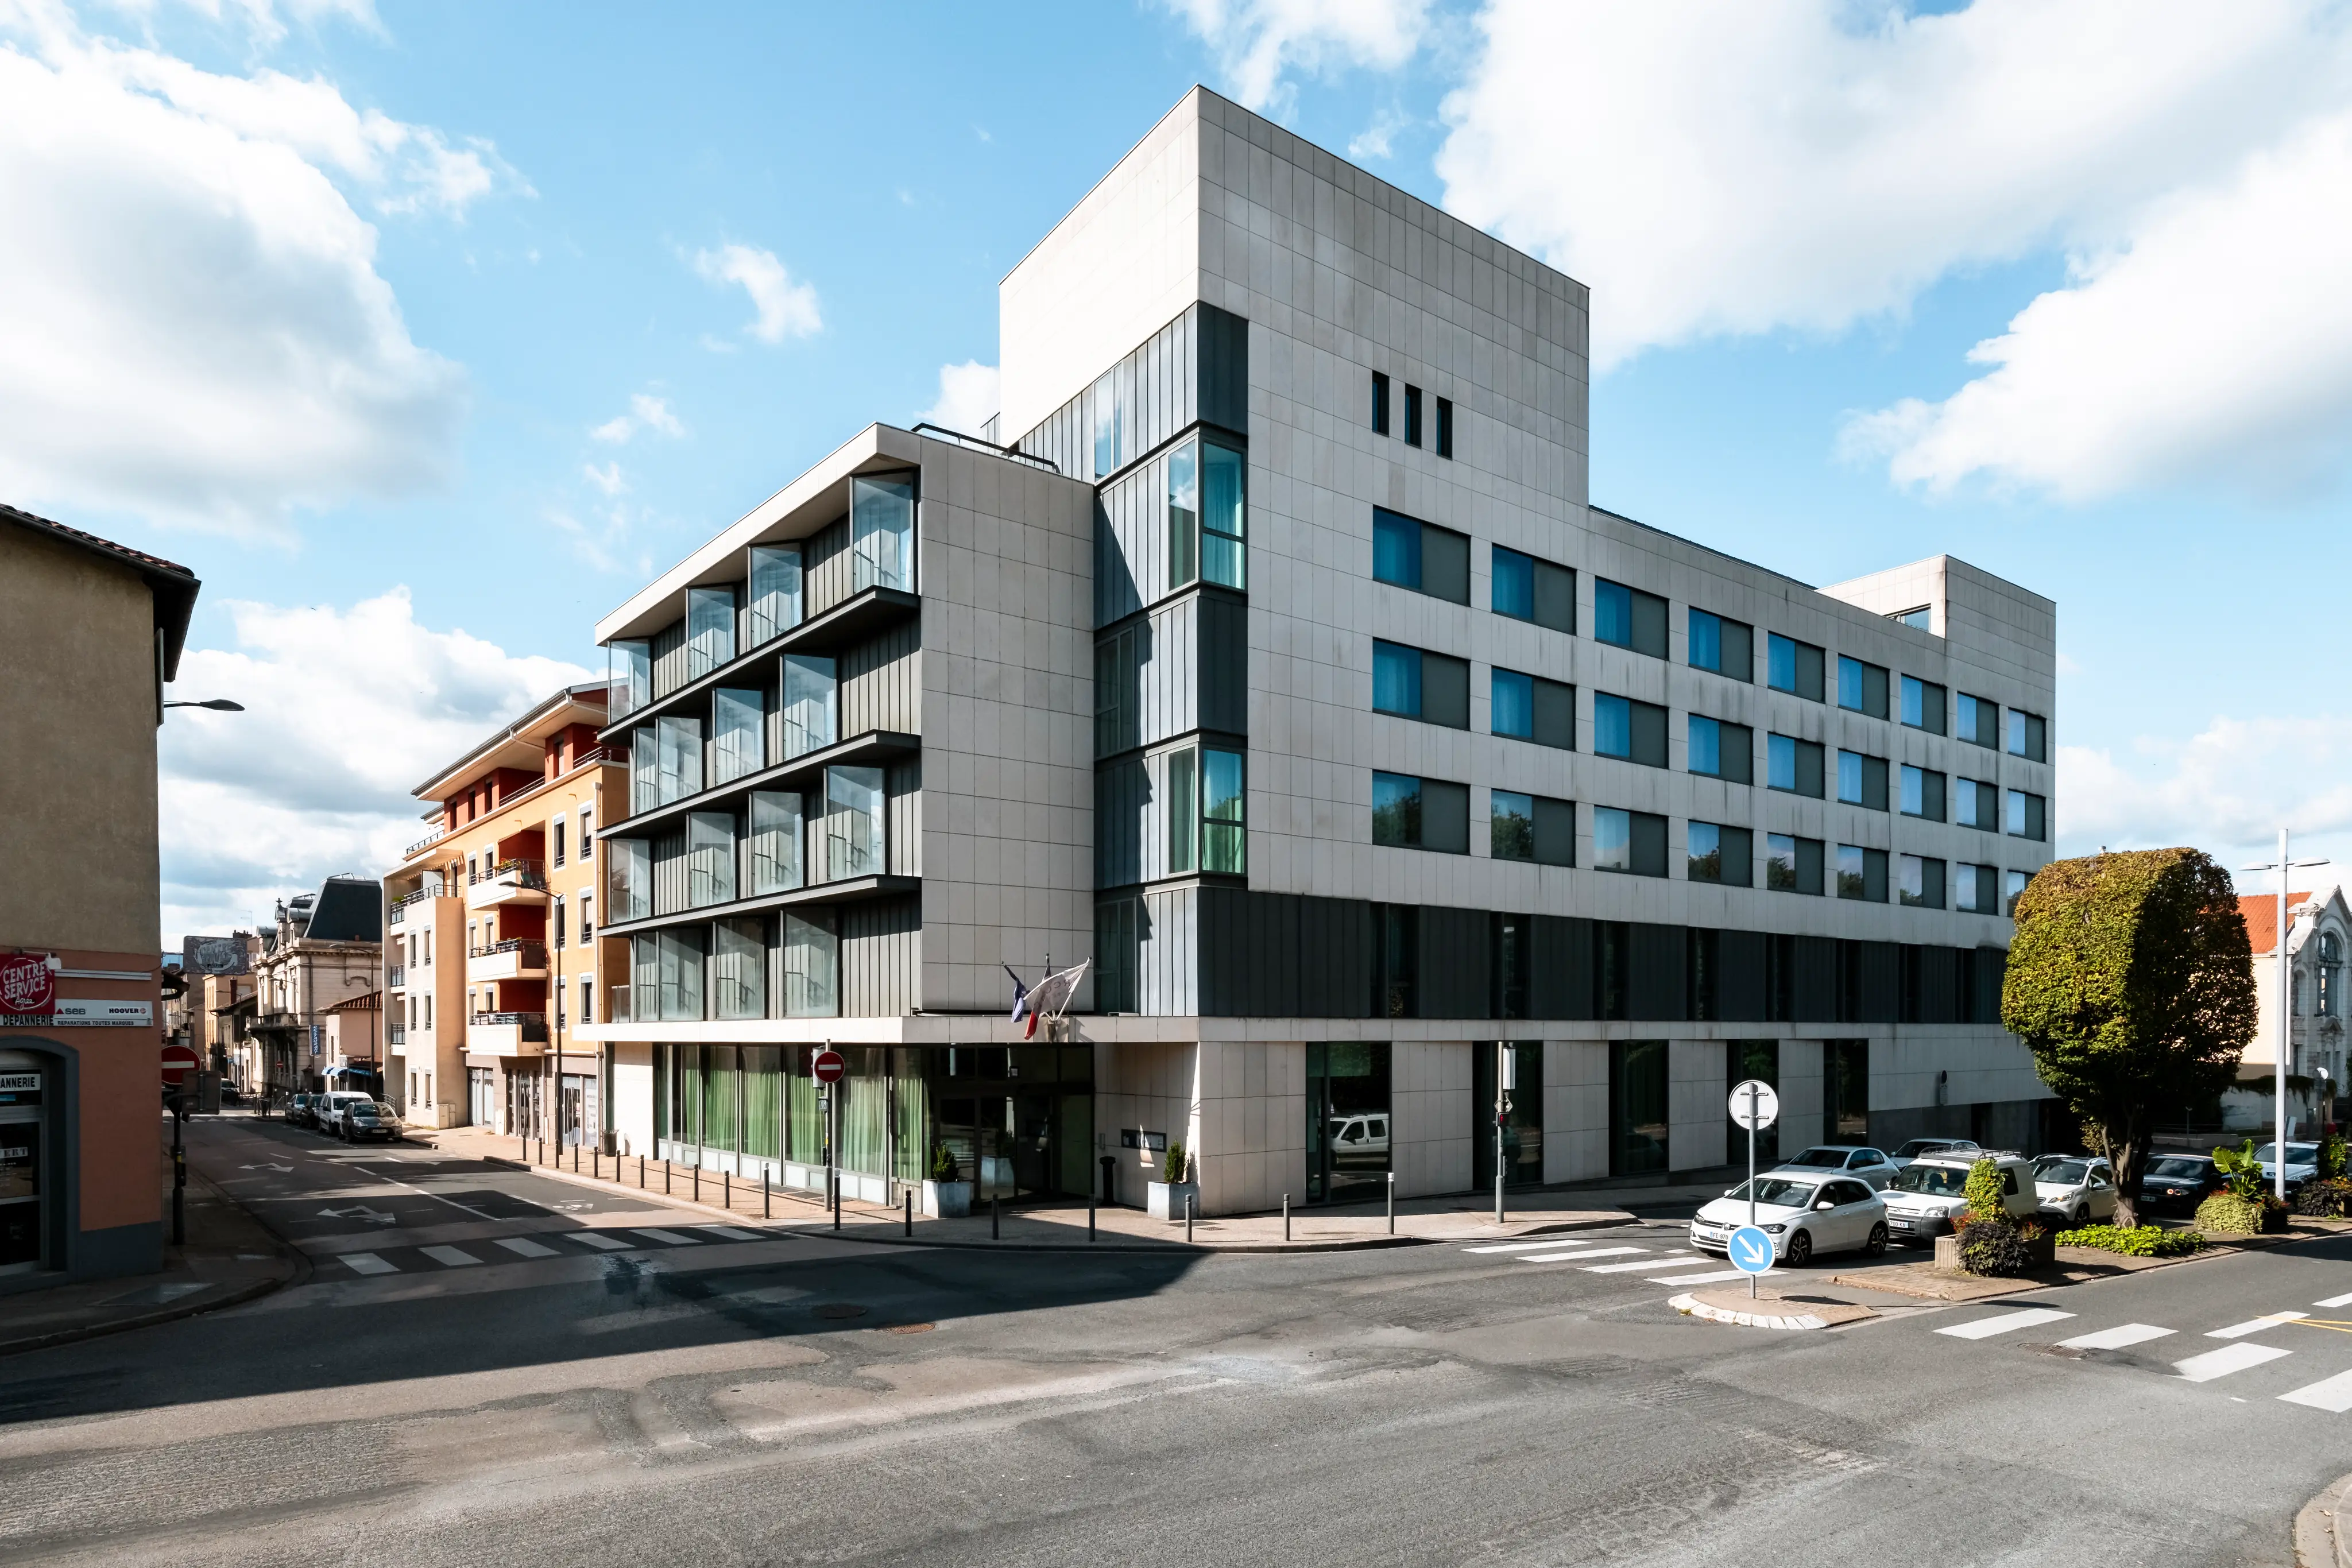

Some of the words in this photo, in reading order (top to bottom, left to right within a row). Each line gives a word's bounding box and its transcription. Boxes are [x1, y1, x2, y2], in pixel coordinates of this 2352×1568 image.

[3, 961, 46, 985] CENTRE
[4, 975, 45, 1000] SERVICE
[3, 1015, 54, 1025] DEPANNERIE
[0, 1077, 36, 1089] ANNERIE
